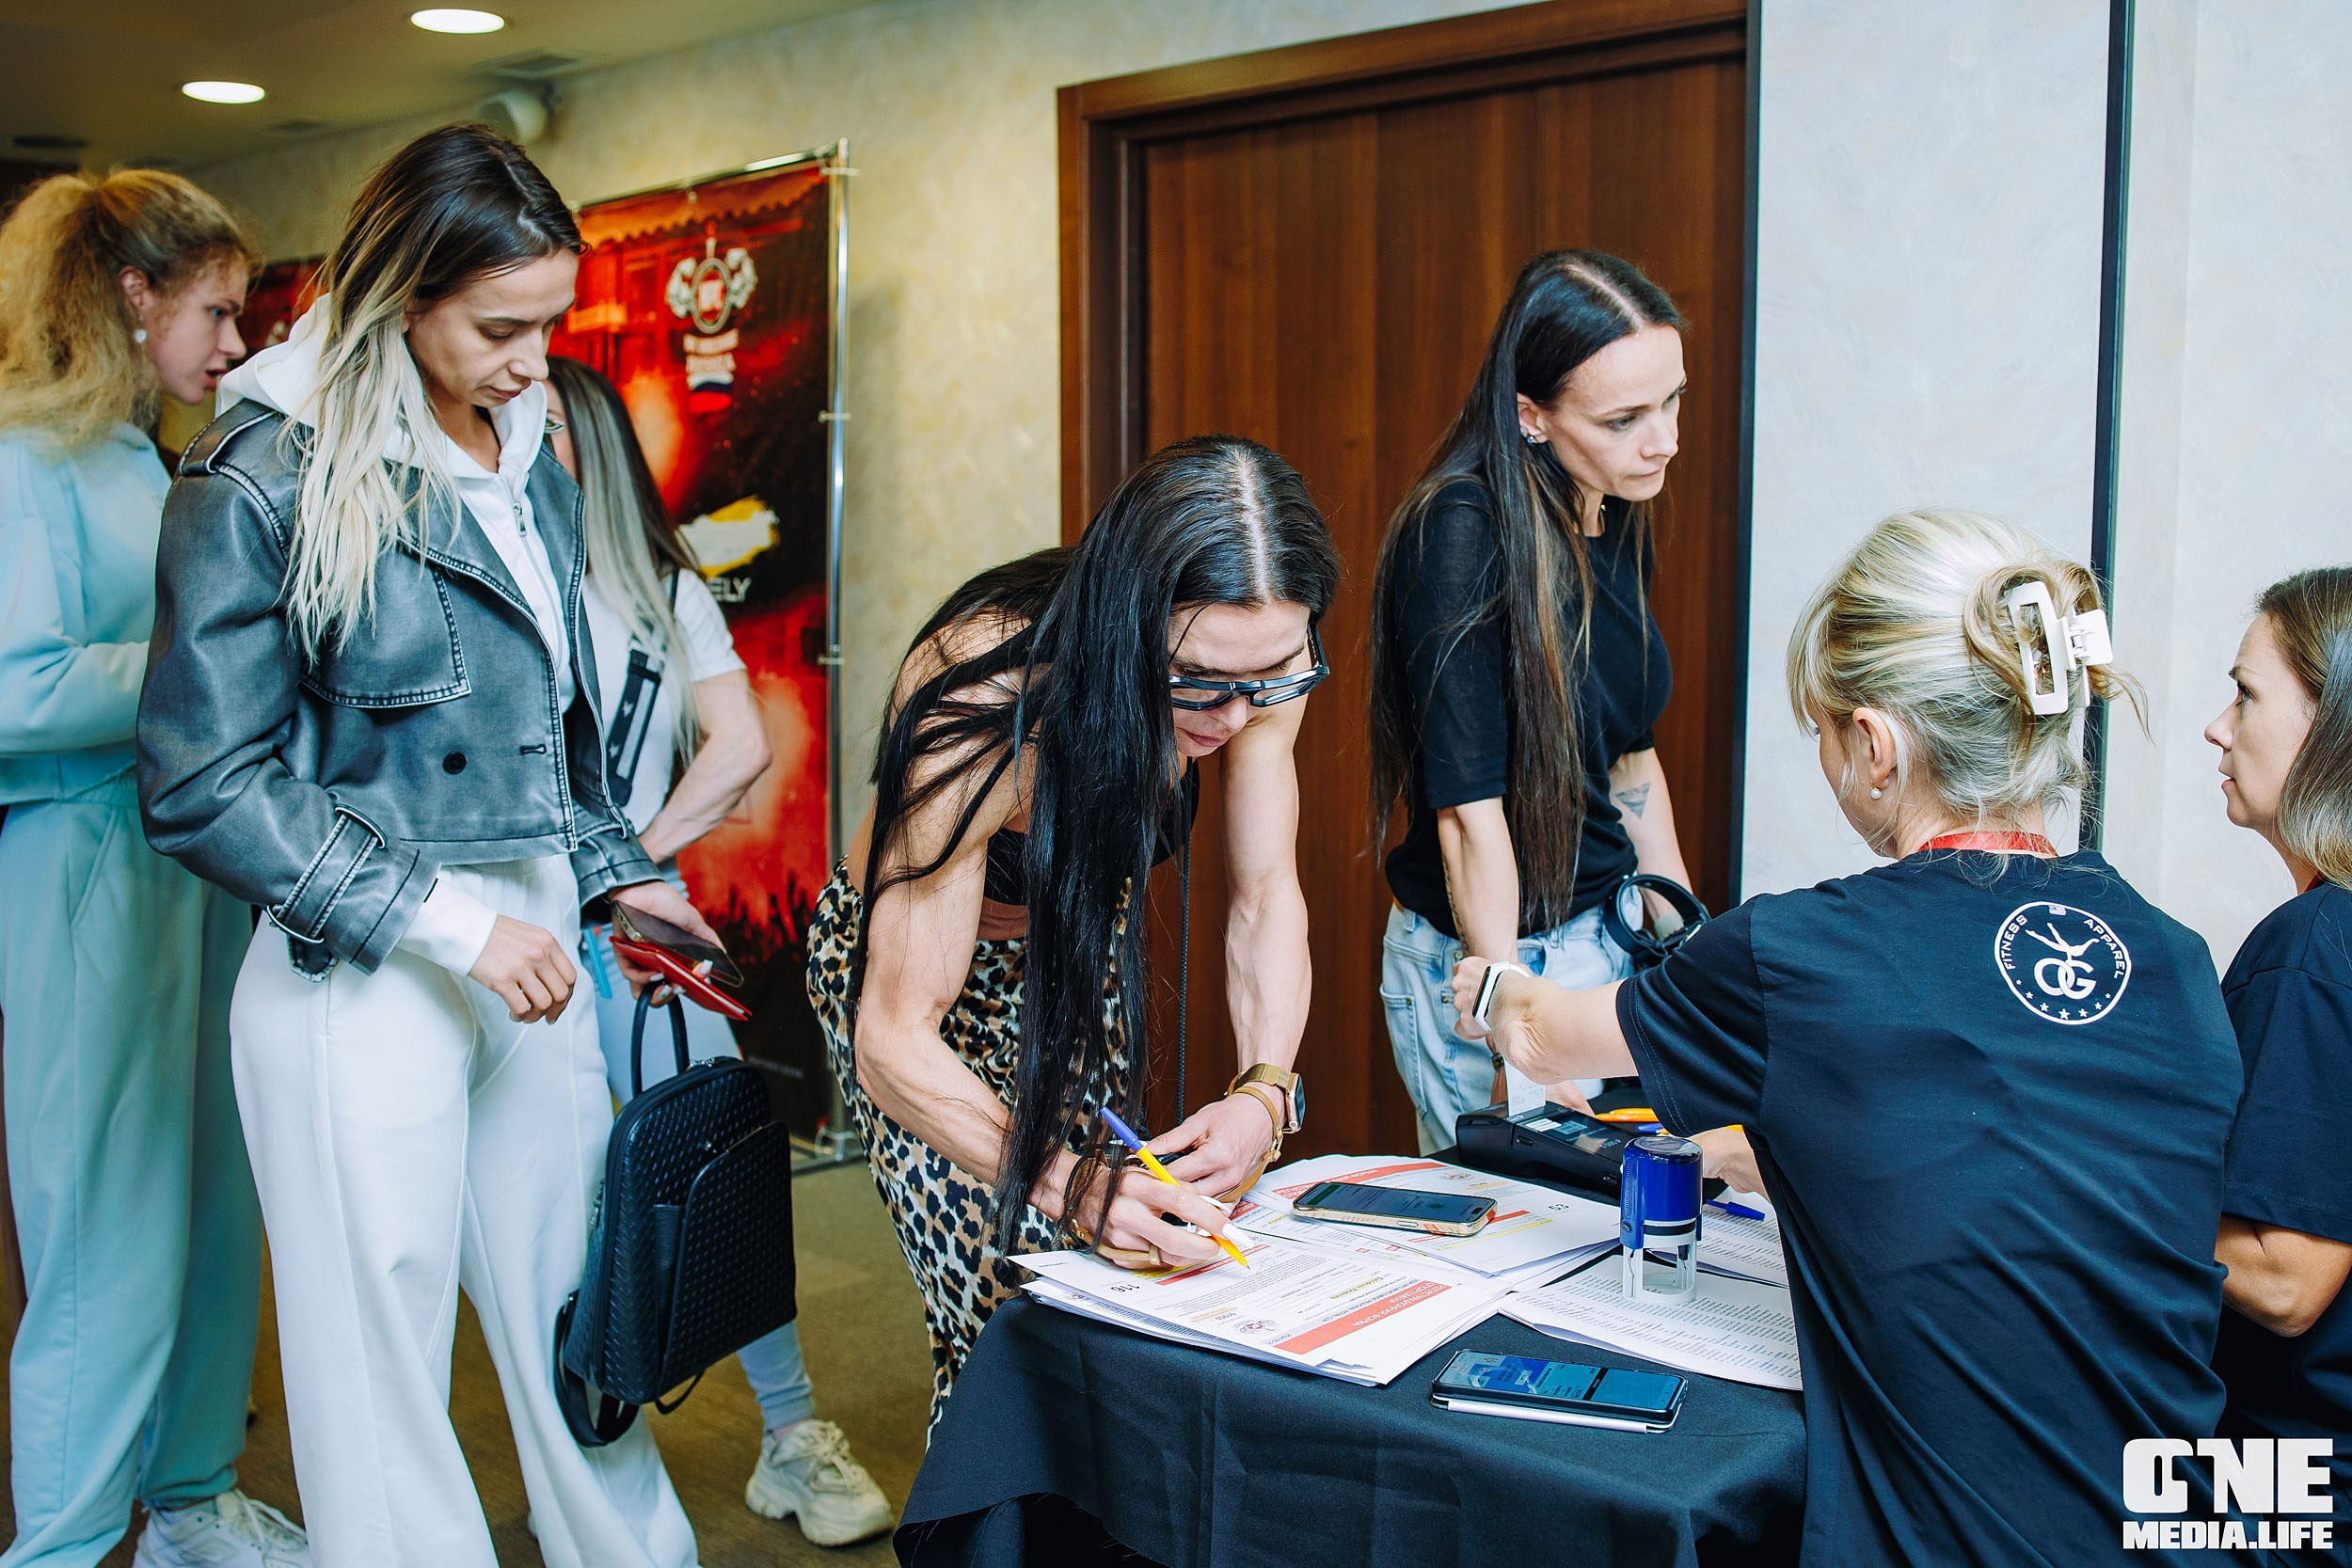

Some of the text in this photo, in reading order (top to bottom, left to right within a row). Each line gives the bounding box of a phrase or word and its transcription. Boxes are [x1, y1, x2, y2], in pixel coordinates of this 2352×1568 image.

[707, 577, 752, 602] ELY
[2000, 914, 2028, 970] FITNESS
[2083, 918, 2126, 979] APPAREL
[2033, 958, 2097, 1000] OG
[1110, 1284, 1139, 1292] 116
